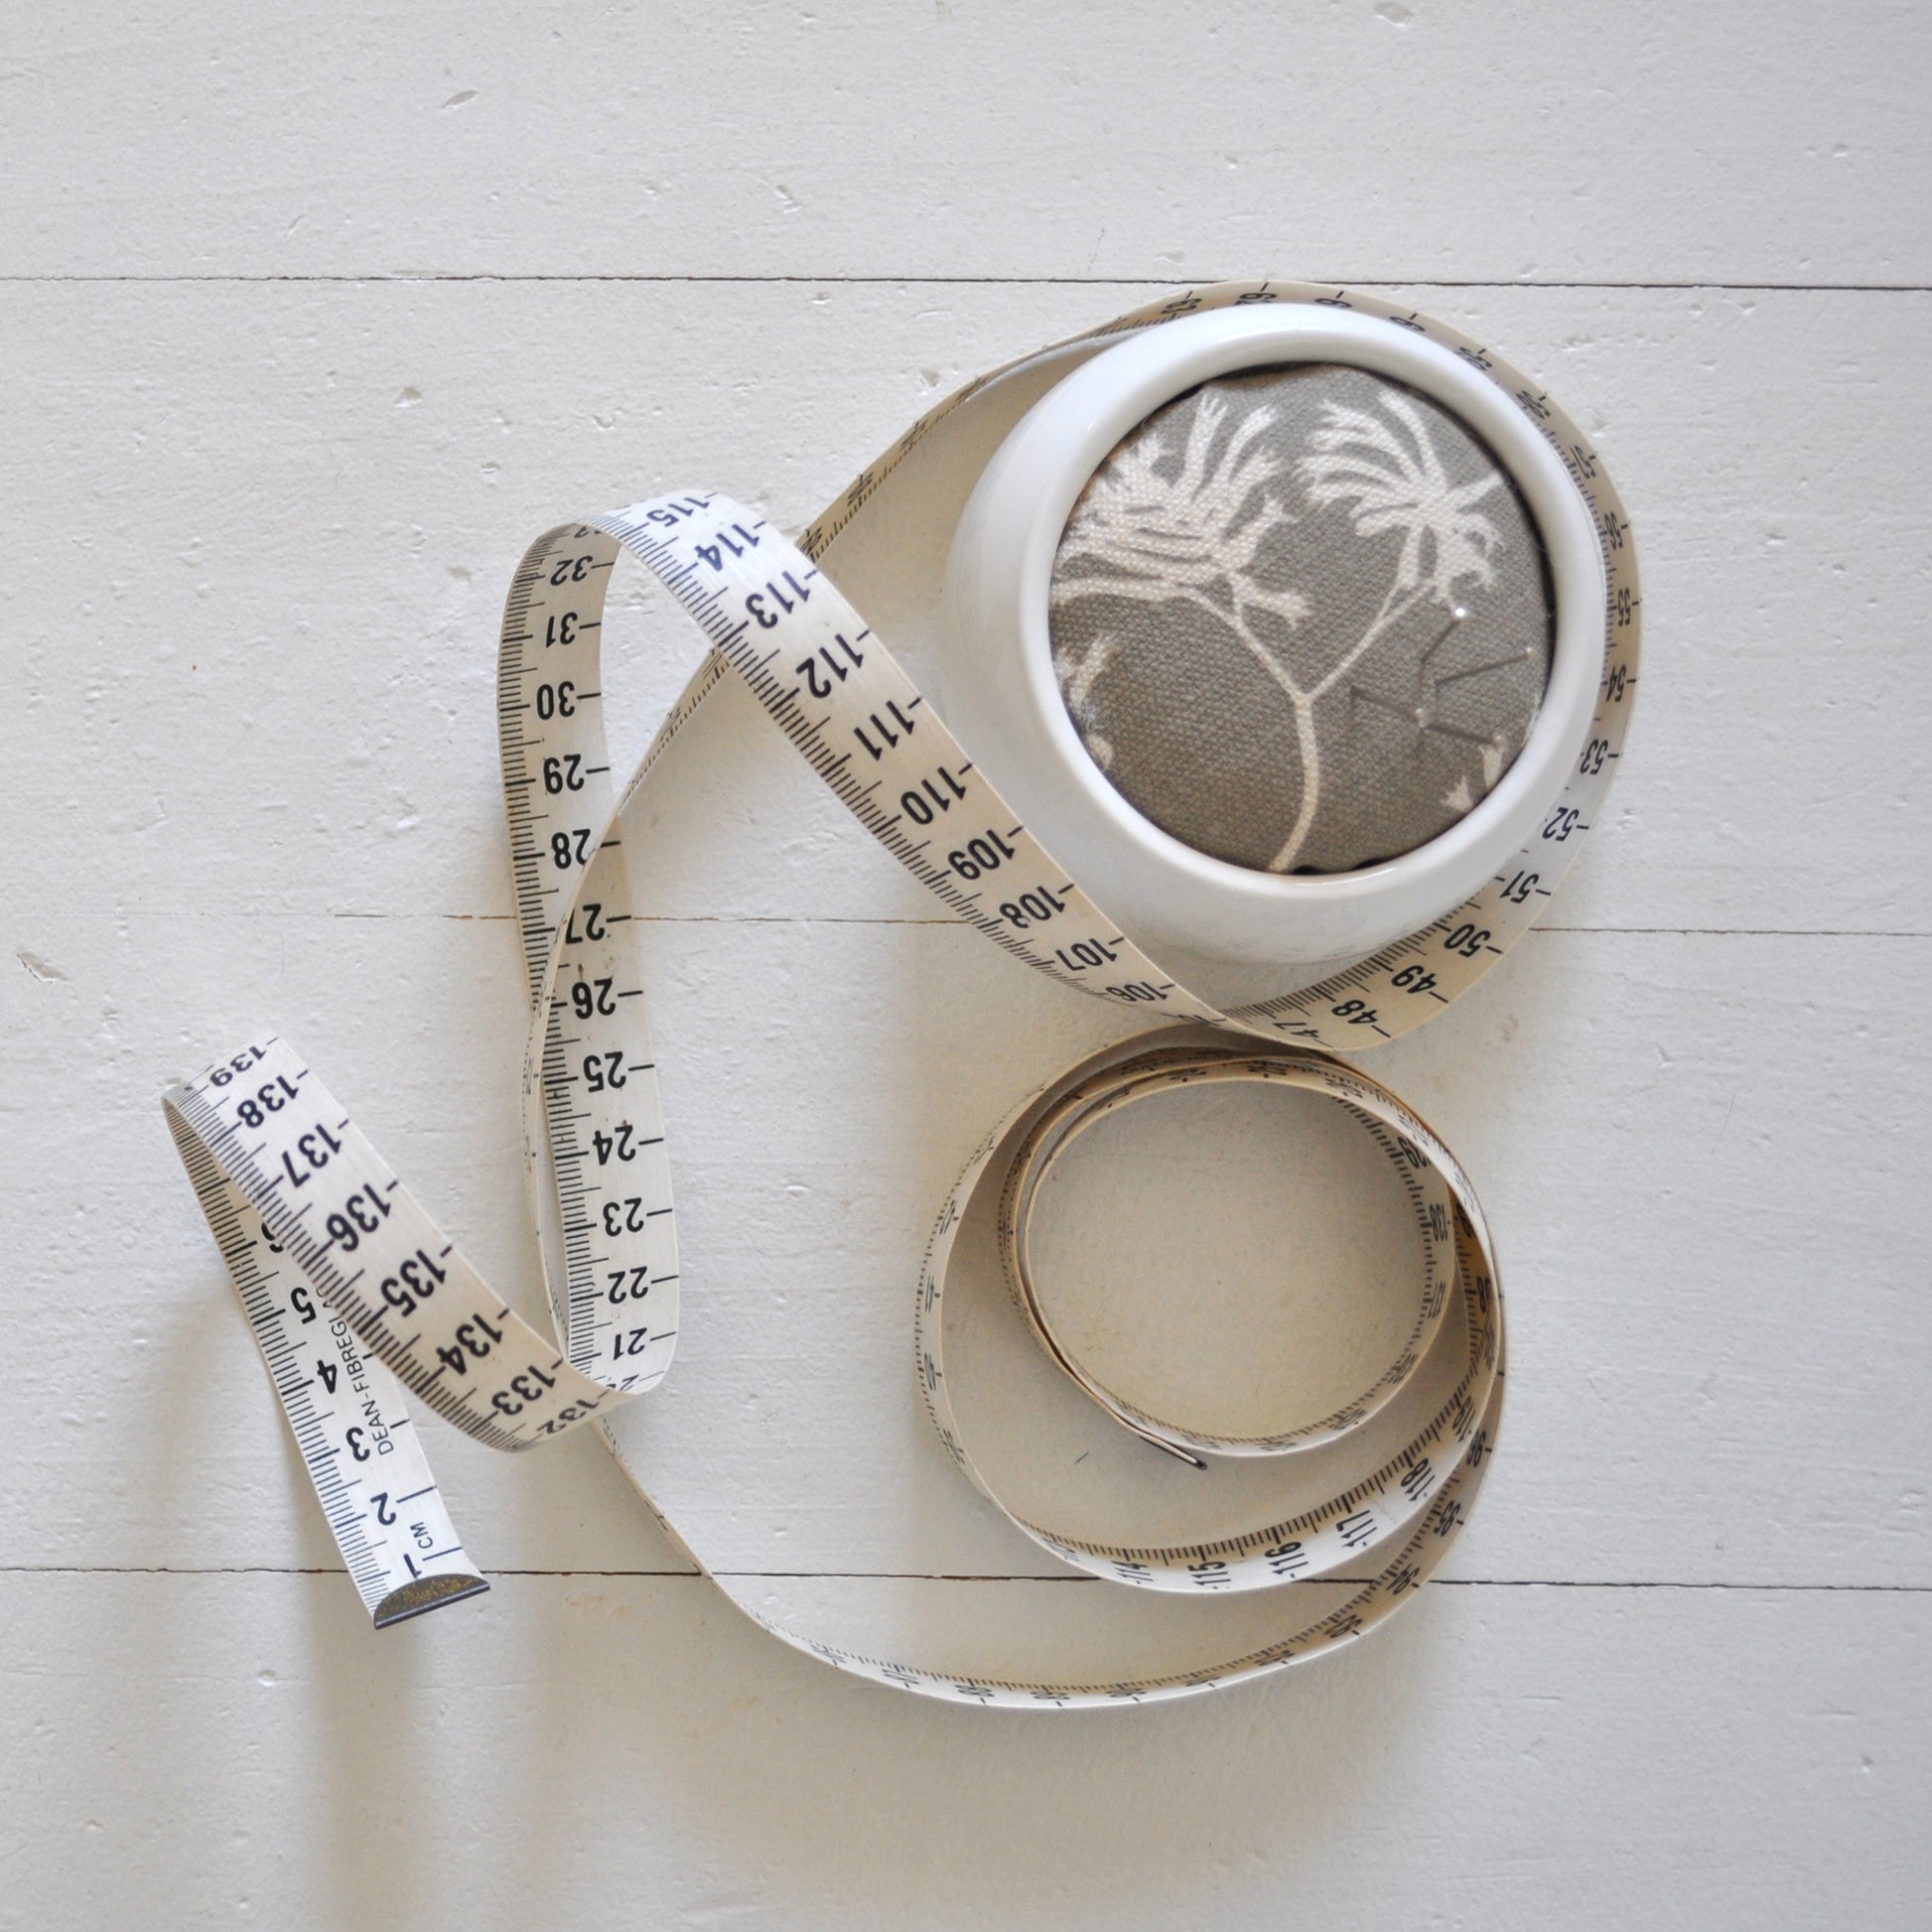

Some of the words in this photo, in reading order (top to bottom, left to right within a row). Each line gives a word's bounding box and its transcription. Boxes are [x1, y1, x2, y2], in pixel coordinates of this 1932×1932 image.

[646, 496, 710, 527] 115
[1604, 511, 1623, 550] 56
[695, 523, 760, 572] 114
[549, 555, 593, 586] 32
[745, 571, 811, 628] 113
[1617, 587, 1631, 626] 55
[545, 612, 578, 648] 31
[795, 633, 864, 698] 112
[1606, 664, 1626, 703] 54
[536, 681, 576, 721] 30
[853, 700, 914, 760] 111
[543, 754, 585, 795] 29
[1580, 740, 1608, 775] 53
[900, 766, 966, 825] 110
[1542, 806, 1580, 842] 52
[551, 828, 591, 870] 28
[947, 829, 1015, 880] 109
[1499, 870, 1539, 904] 51
[565, 902, 606, 944] 27
[999, 886, 1065, 928] 108
[1055, 938, 1117, 971] 107
[1444, 923, 1491, 958] 50
[1105, 981, 1168, 1002] 106
[1391, 964, 1436, 994] 49
[571, 978, 616, 1020] 26
[1331, 999, 1378, 1026] 48
[1272, 1022, 1319, 1038] 47
[209, 1045, 267, 1087] 139
[583, 1050, 626, 1093] 25
[236, 1075, 299, 1128] 138
[281, 1124, 342, 1187] 137
[592, 1124, 636, 1166] 24
[326, 1183, 391, 1252] 136
[602, 1196, 644, 1237] 23
[380, 1249, 446, 1316] 135
[608, 1266, 648, 1305] 22
[290, 1287, 317, 1324] 5
[436, 1313, 503, 1374] 134
[613, 1327, 647, 1361] 21
[317, 1360, 338, 1394] 4
[490, 1365, 557, 1416] 133
[536, 1399, 599, 1435] 132
[345, 1427, 370, 1462] 3
[1400, 1457, 1436, 1501] 118
[369, 1492, 396, 1526] 2
[1335, 1509, 1378, 1548] 117
[409, 1520, 433, 1550] CM
[403, 1554, 422, 1579] 1
[1111, 1560, 1154, 1582] 114
[1187, 1561, 1231, 1586] 115
[1264, 1541, 1309, 1576] 116
